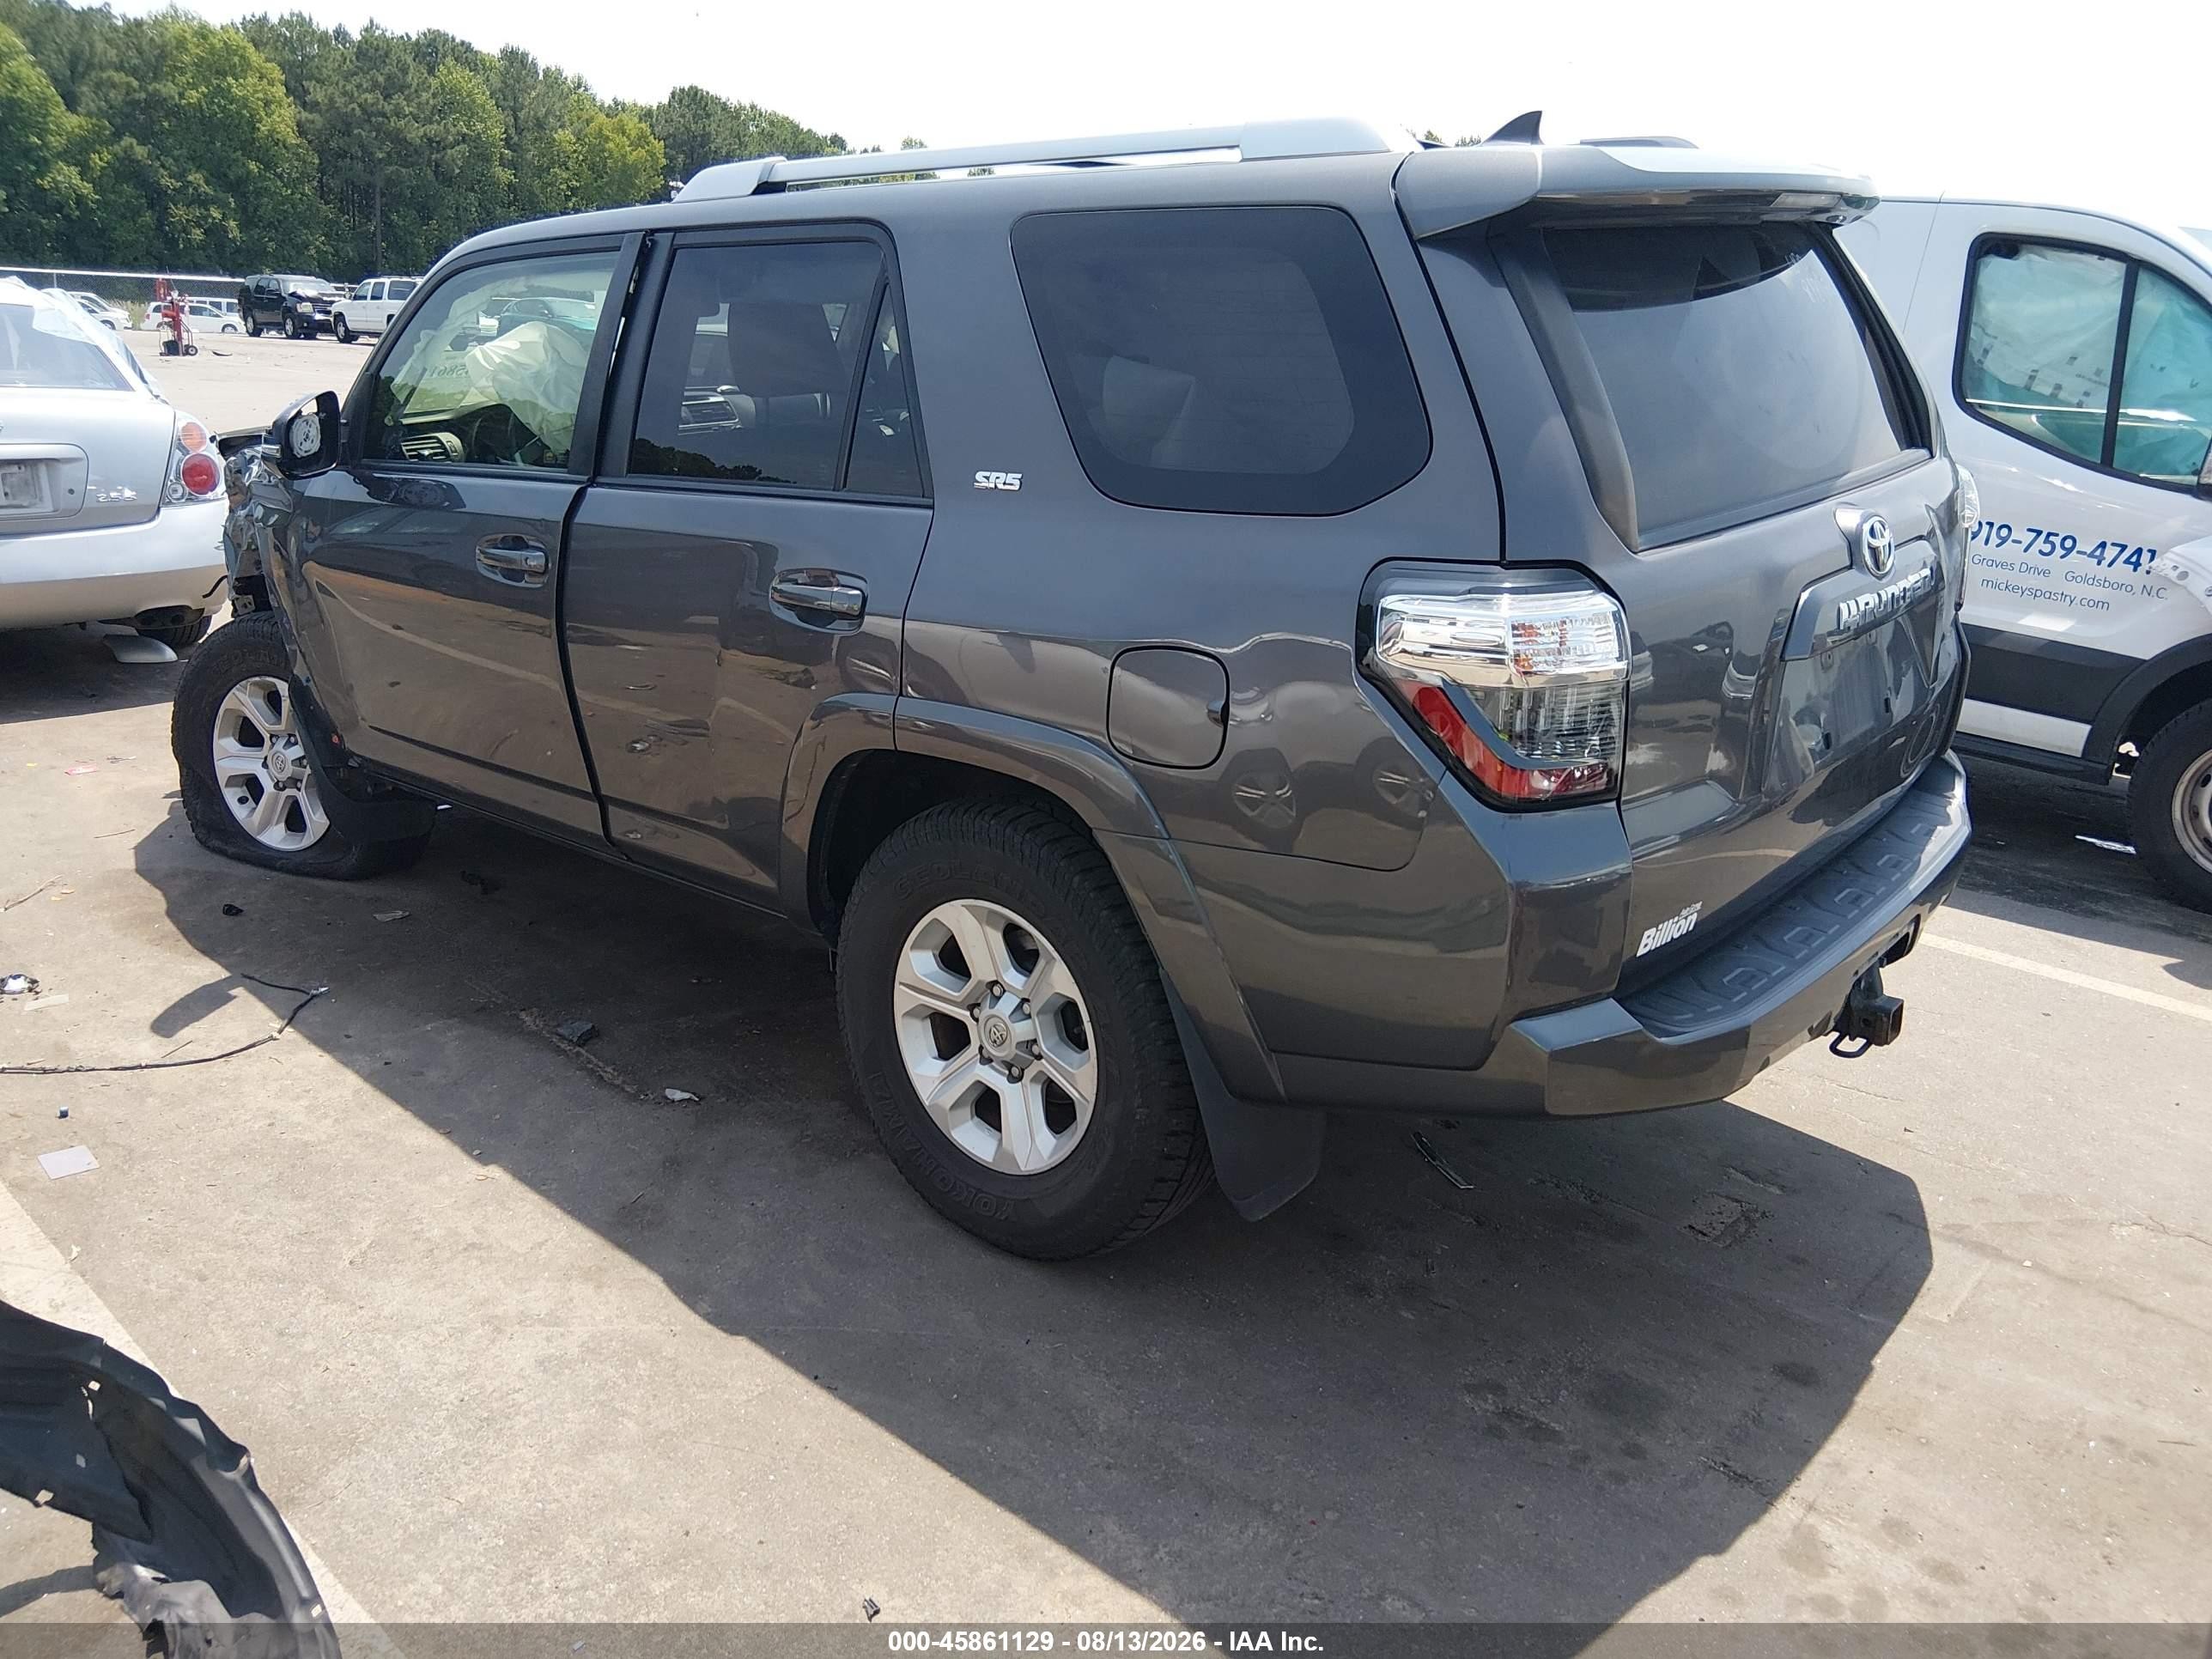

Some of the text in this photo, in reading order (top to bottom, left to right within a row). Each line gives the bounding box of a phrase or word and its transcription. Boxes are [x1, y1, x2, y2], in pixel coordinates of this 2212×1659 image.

[974, 471, 1022, 490] SR5
[1972, 553, 2168, 600] Graves Drive Goldsboro, N.C.
[1981, 577, 2110, 611] mickeyspastry.com
[1636, 912, 1698, 957] Billion
